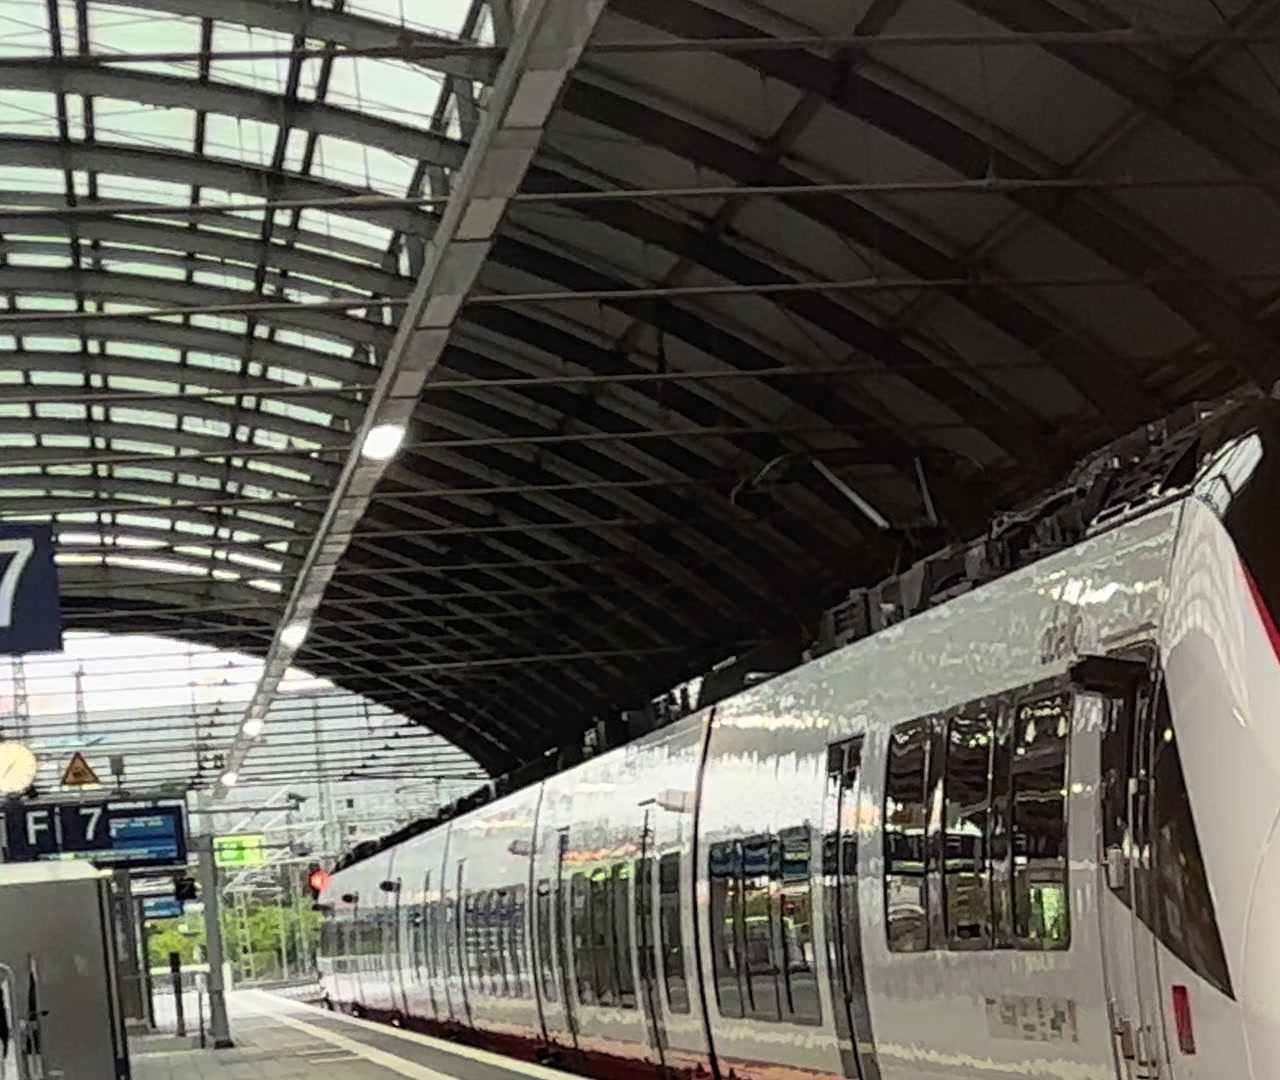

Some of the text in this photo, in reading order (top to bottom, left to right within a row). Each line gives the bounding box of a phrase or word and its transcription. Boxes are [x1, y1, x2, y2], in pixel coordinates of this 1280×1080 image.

[0, 538, 34, 628] 7
[25, 806, 104, 845] F 7
